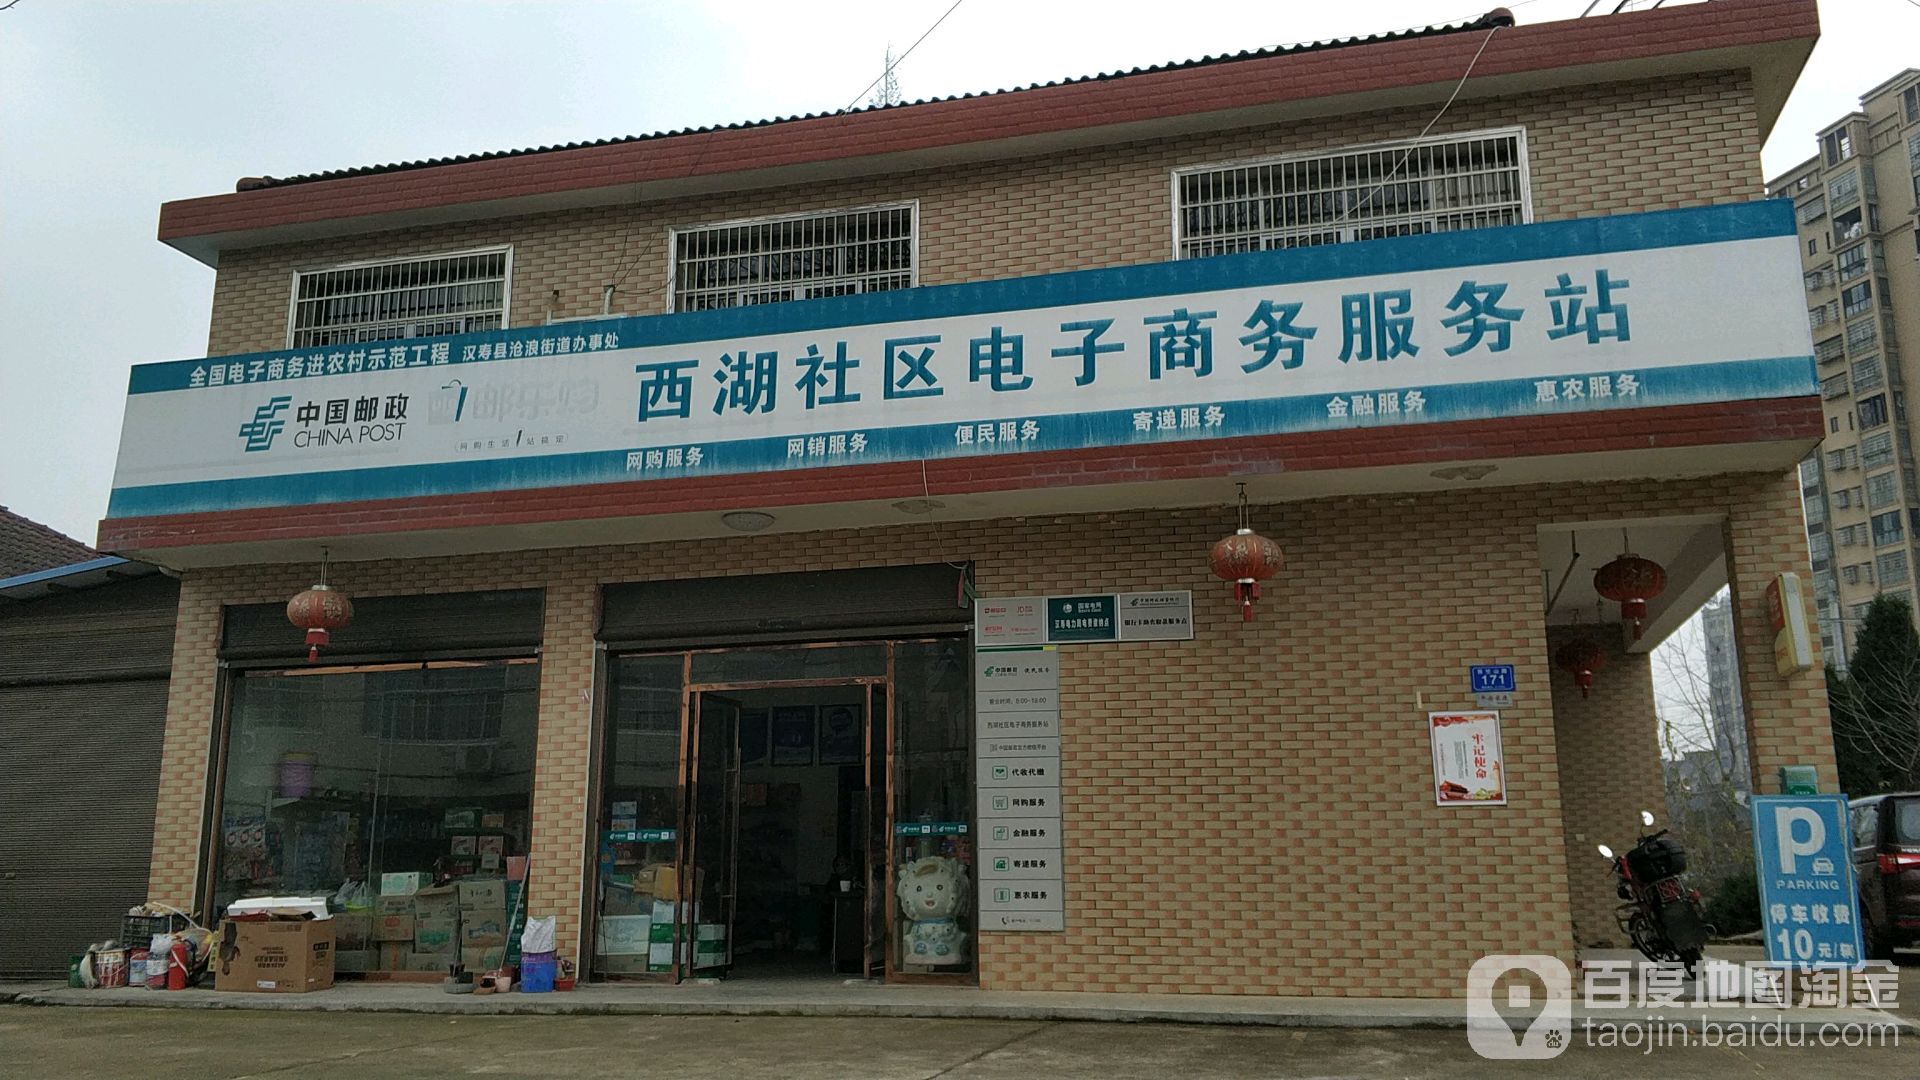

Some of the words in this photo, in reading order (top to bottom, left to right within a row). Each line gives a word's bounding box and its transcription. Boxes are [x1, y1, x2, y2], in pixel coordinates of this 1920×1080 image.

[462, 332, 619, 362] 汉寿县沧浪街道办事处
[635, 268, 1632, 422] 西湖社区电子商务服务站
[189, 342, 449, 388] 全国电子商务进农村示范工程
[1534, 373, 1641, 402] 惠农服务
[296, 393, 410, 427] 中国邮政
[1327, 389, 1426, 418] 金融服务
[1132, 405, 1226, 432] 寄递服务
[294, 428, 353, 448] CHINA
[359, 422, 408, 443] POST
[787, 432, 868, 458] 网销服务
[954, 419, 1041, 445] 便民服务
[626, 446, 704, 471] 网购服务
[1481, 674, 1505, 686] 171
[1472, 733, 1487, 779] 牢记使命
[1012, 798, 1046, 807] 网购服务
[1013, 829, 1046, 837] 金融服务
[1774, 806, 1826, 875] P
[1776, 880, 1840, 890] PARKING
[1770, 903, 1850, 925] 停车收费
